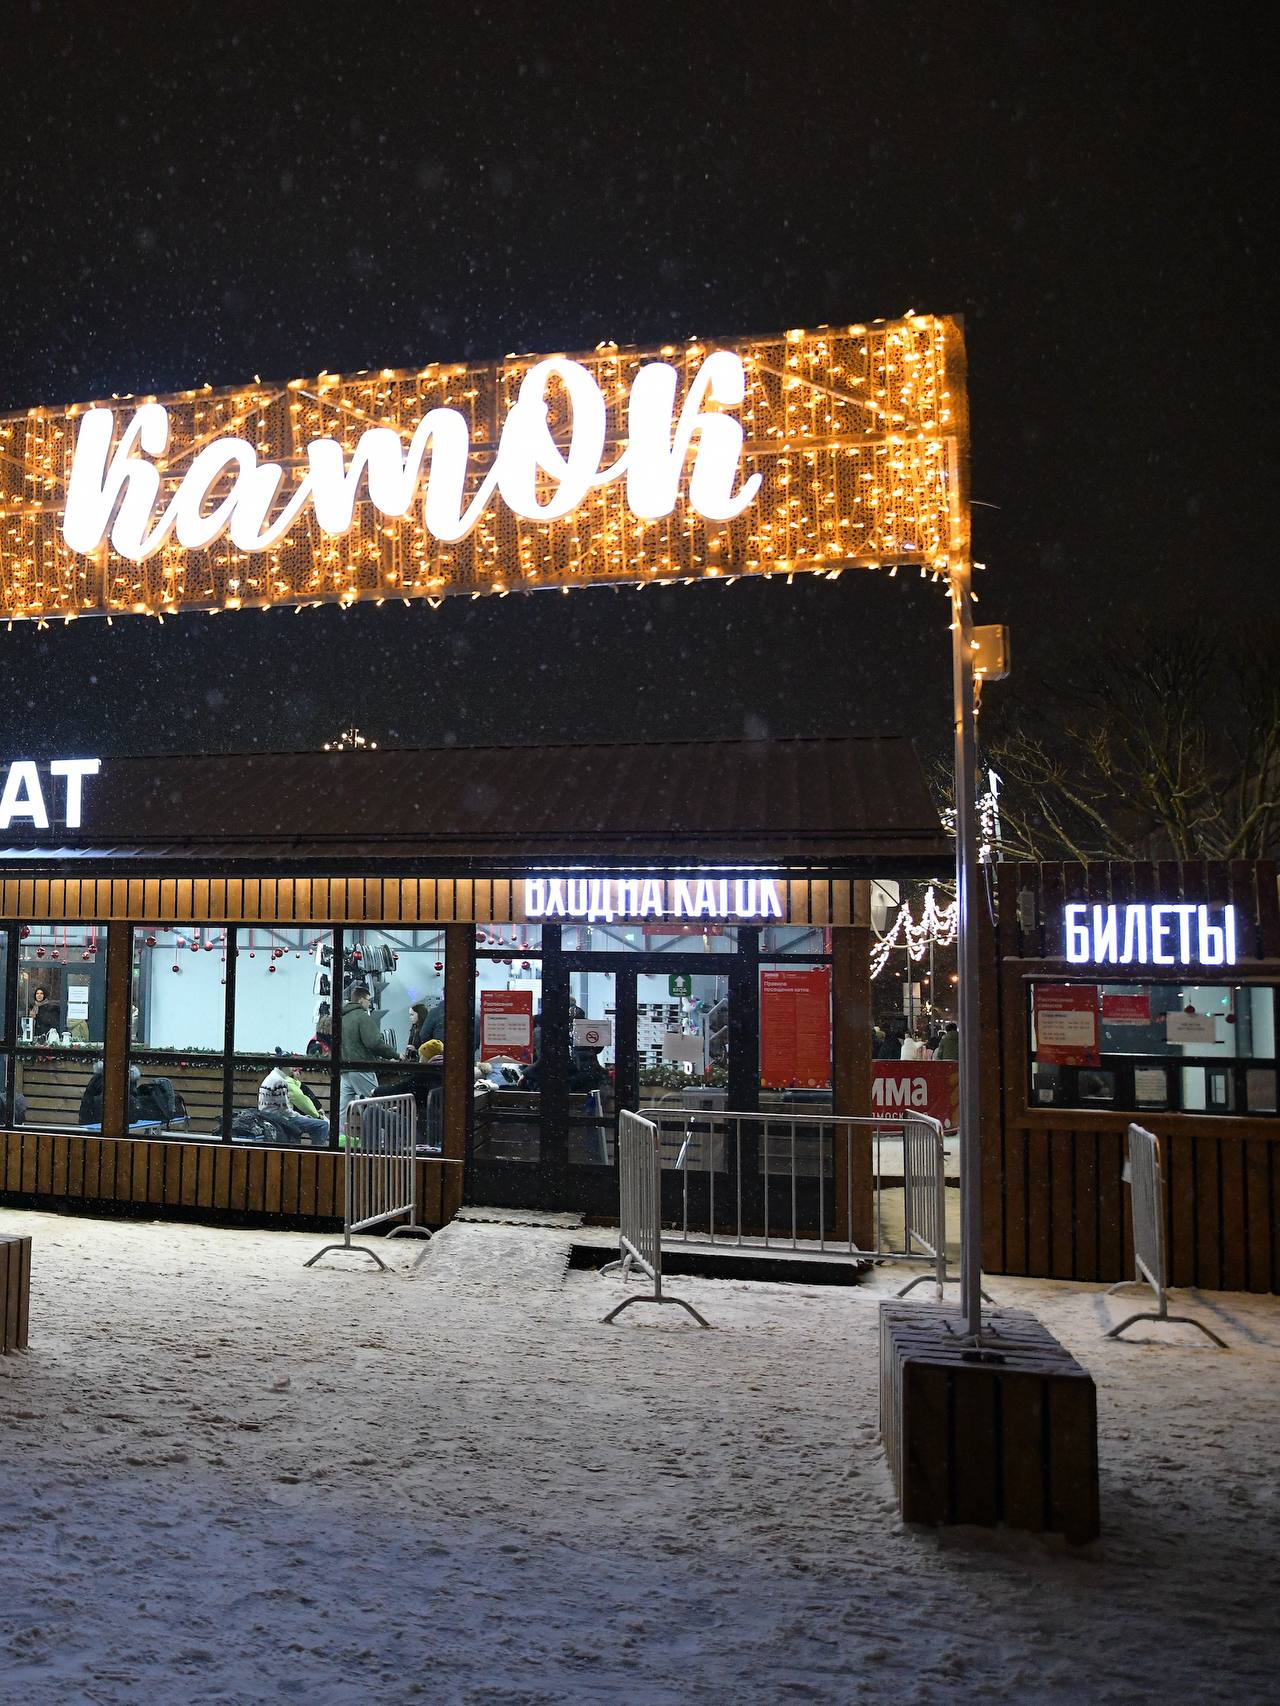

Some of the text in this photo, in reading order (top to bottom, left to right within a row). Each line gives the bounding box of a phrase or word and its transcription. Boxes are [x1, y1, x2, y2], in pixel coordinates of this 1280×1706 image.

[525, 878, 614, 922] ВХОД
[618, 878, 663, 917] НА
[1065, 903, 1236, 966] БИЛЕТЫ
[872, 1077, 928, 1107] има
